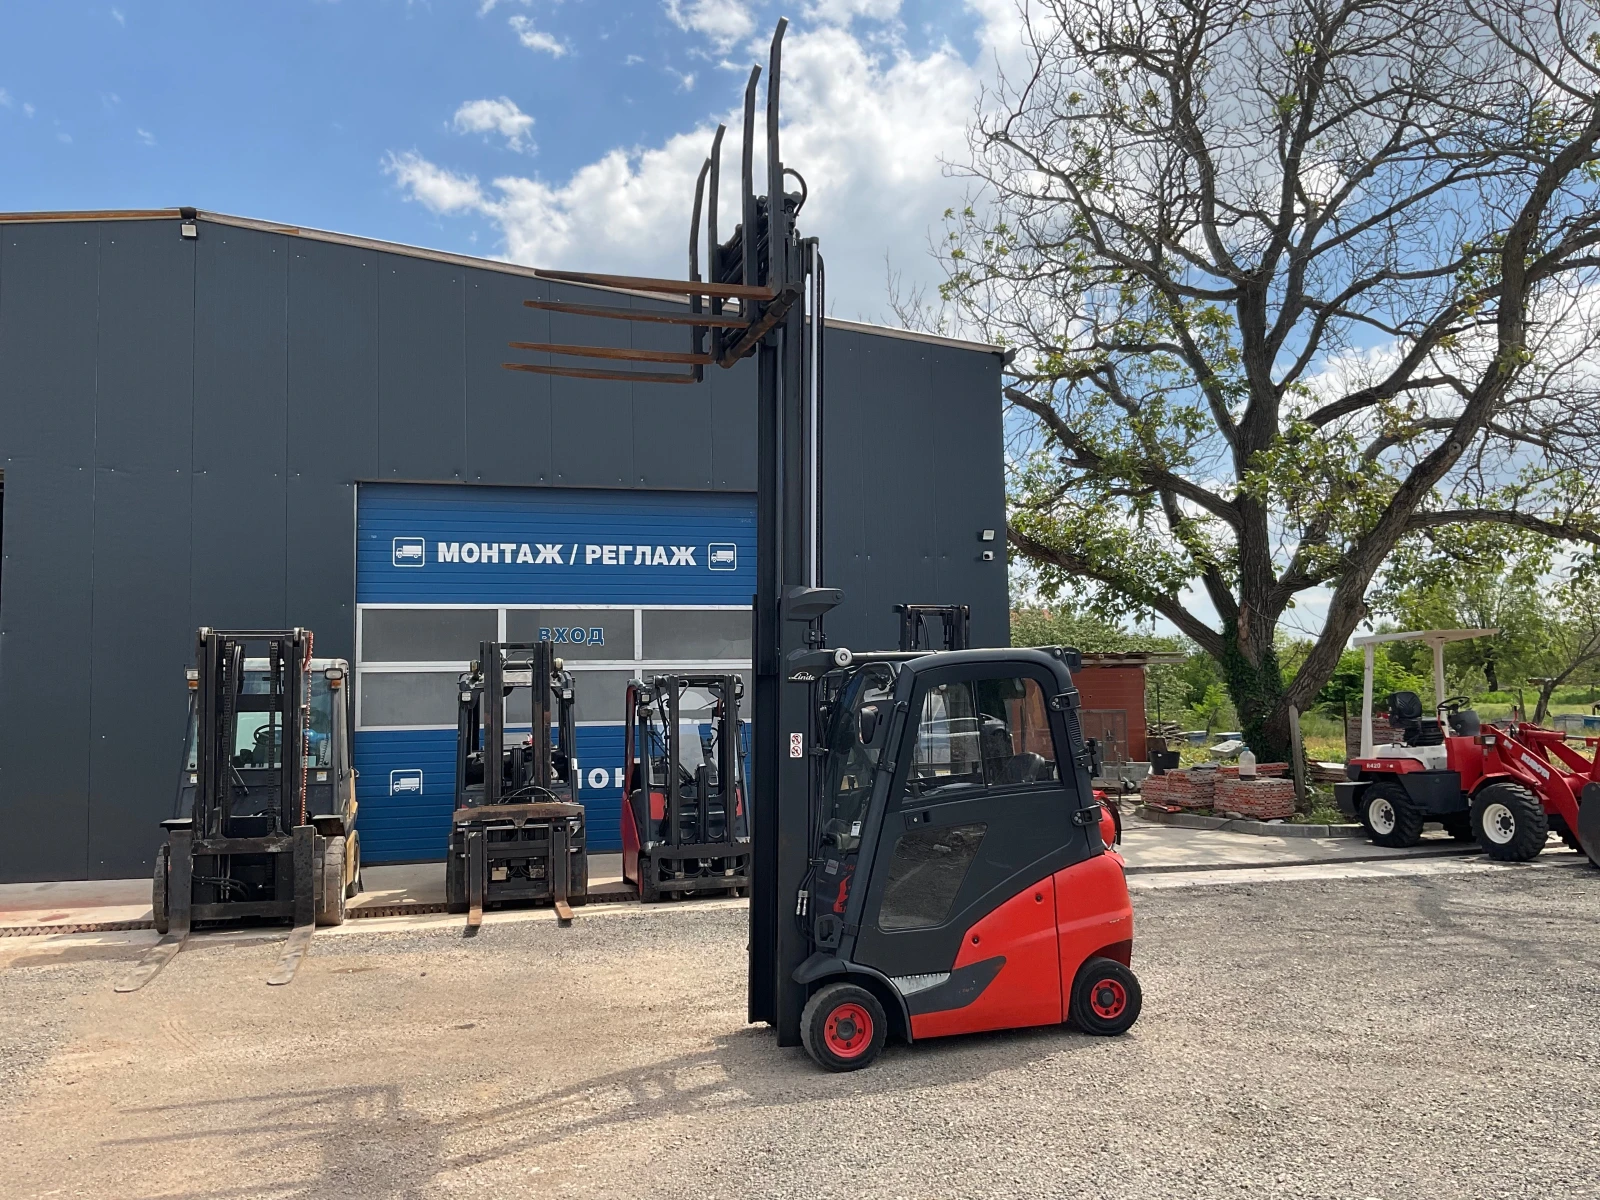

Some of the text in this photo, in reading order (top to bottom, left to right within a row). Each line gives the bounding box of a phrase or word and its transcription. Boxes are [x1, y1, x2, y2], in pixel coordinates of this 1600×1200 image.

[438, 542, 697, 565] МОНТАЖ / РЕГЛАЖ
[539, 627, 605, 646] ВХОД
[789, 671, 815, 681] Linde
